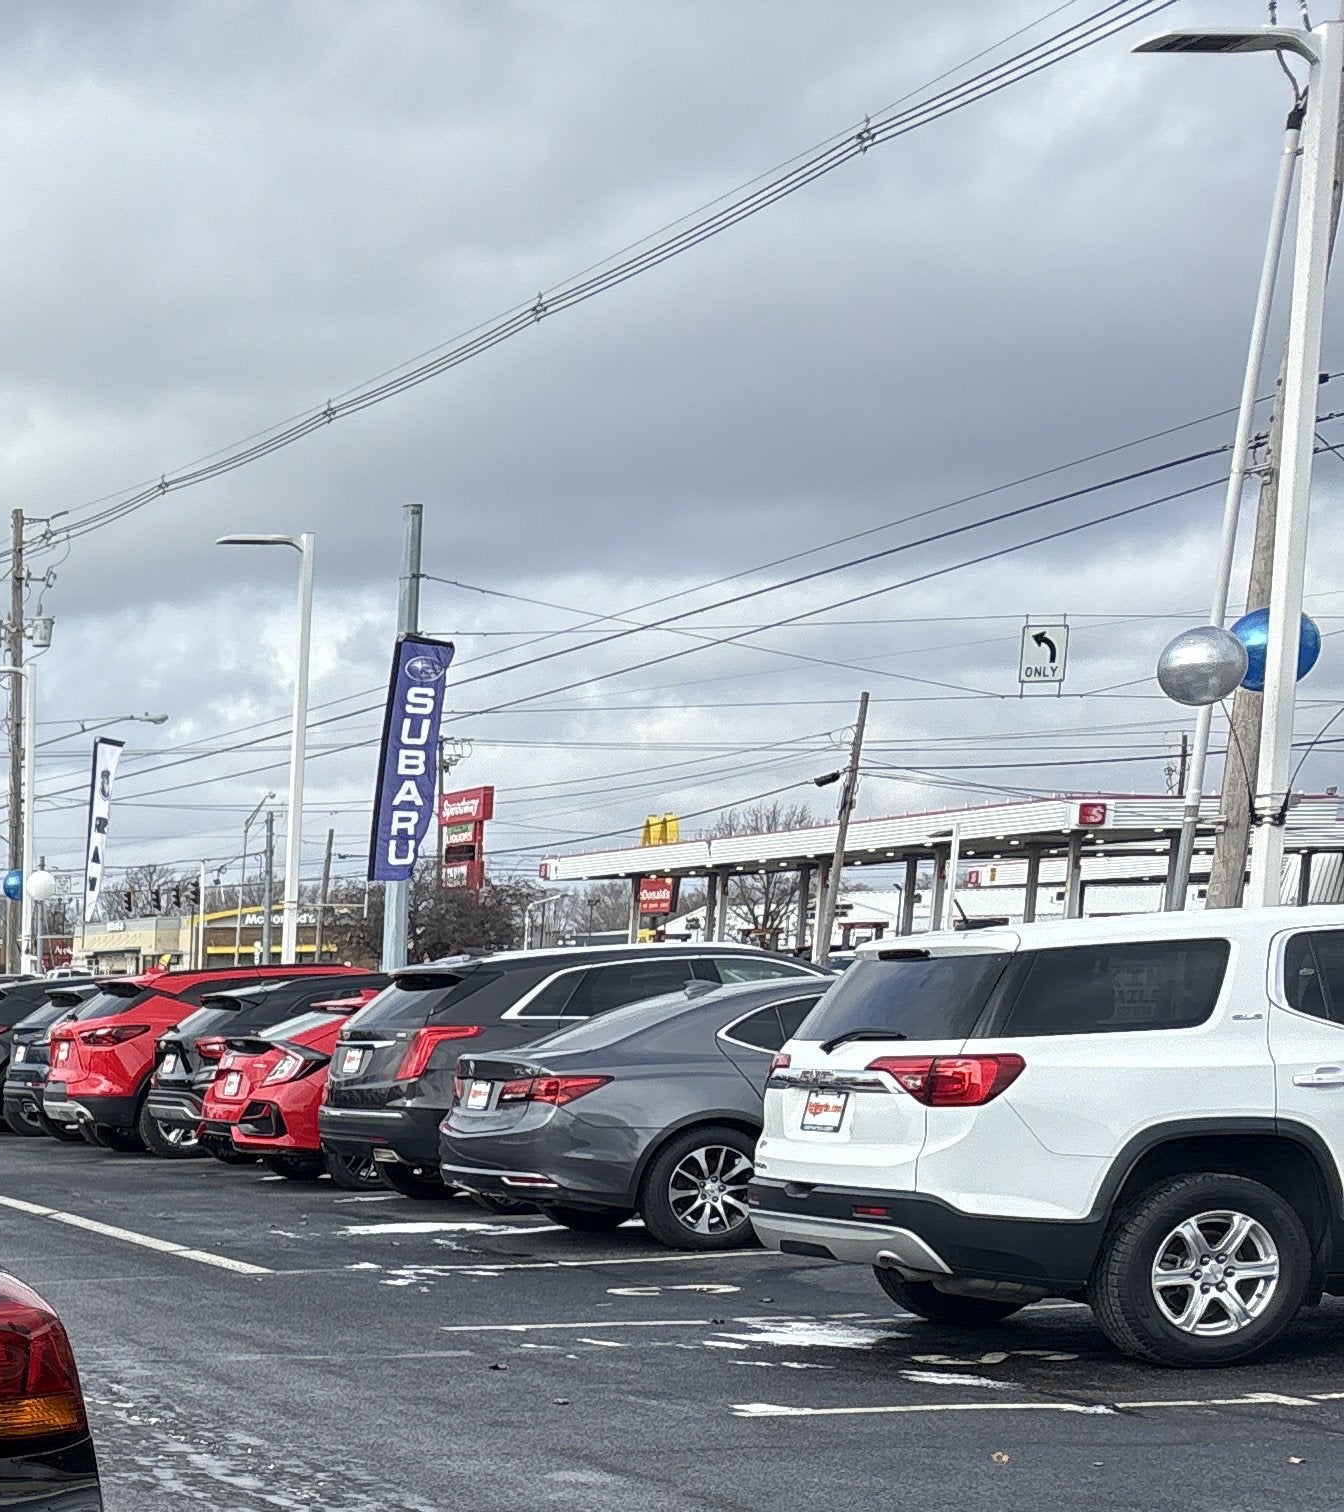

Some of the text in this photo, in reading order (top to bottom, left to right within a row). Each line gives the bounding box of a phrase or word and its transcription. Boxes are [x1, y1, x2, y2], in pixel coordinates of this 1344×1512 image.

[1024, 665, 1060, 678] ONLY
[387, 686, 436, 866] SUBARU
[244, 912, 316, 925] Mcod's
